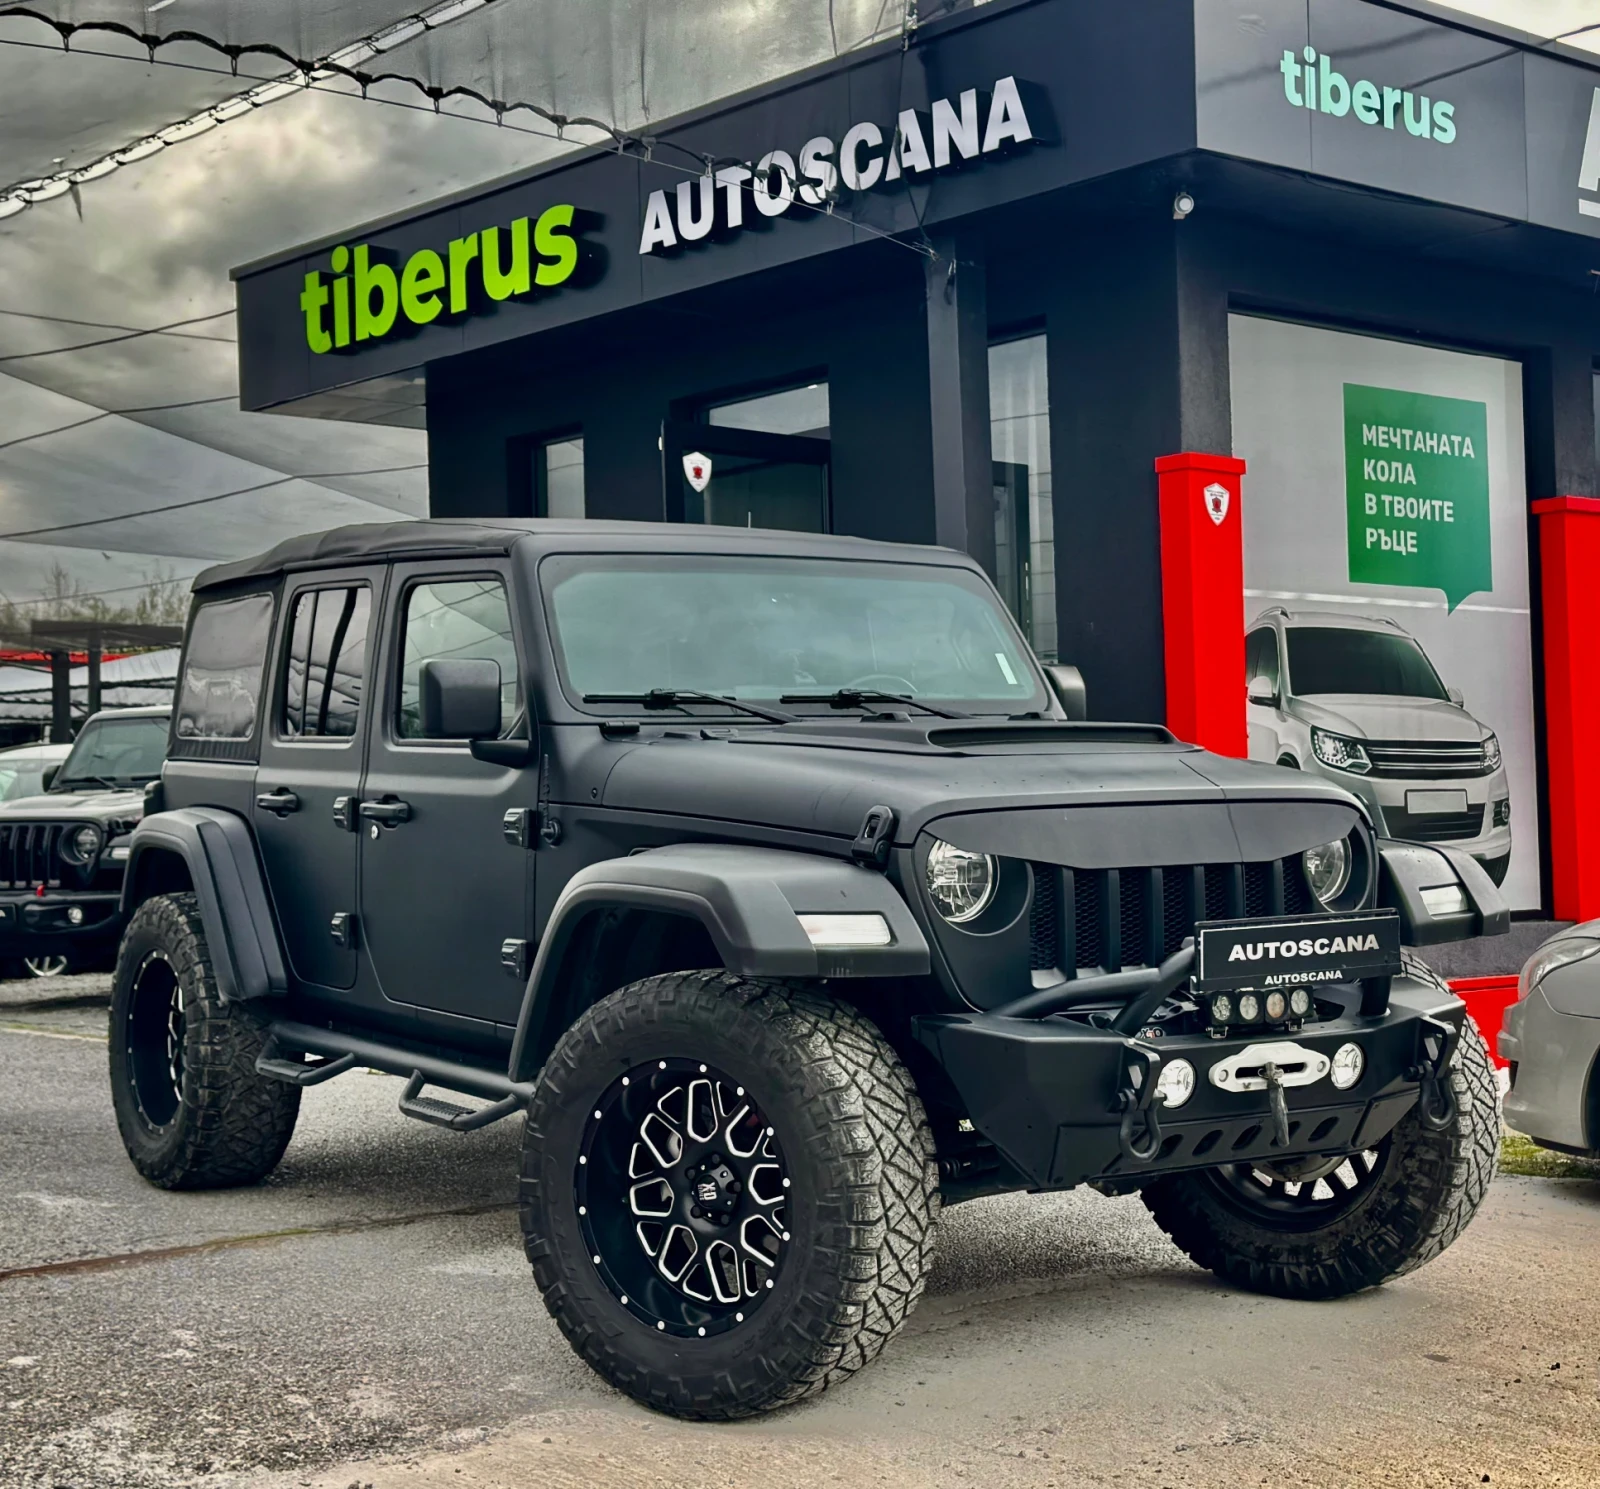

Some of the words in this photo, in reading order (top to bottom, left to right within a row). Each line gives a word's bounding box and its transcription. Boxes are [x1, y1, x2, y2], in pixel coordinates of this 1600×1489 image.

[1280, 45, 1457, 144] tiberus
[301, 204, 577, 354] tiberus
[639, 75, 1033, 255] AUTOSCANA
[1362, 424, 1475, 459] МЕЧТАНАТА
[1363, 458, 1417, 485] КОЛА
[1365, 493, 1377, 515] В
[1381, 494, 1455, 522] ТВОИТЕ
[1366, 527, 1418, 556] РЪЦЕ
[1228, 934, 1380, 962] AUTOSCANA
[1266, 969, 1343, 985] AUTOSCANA
